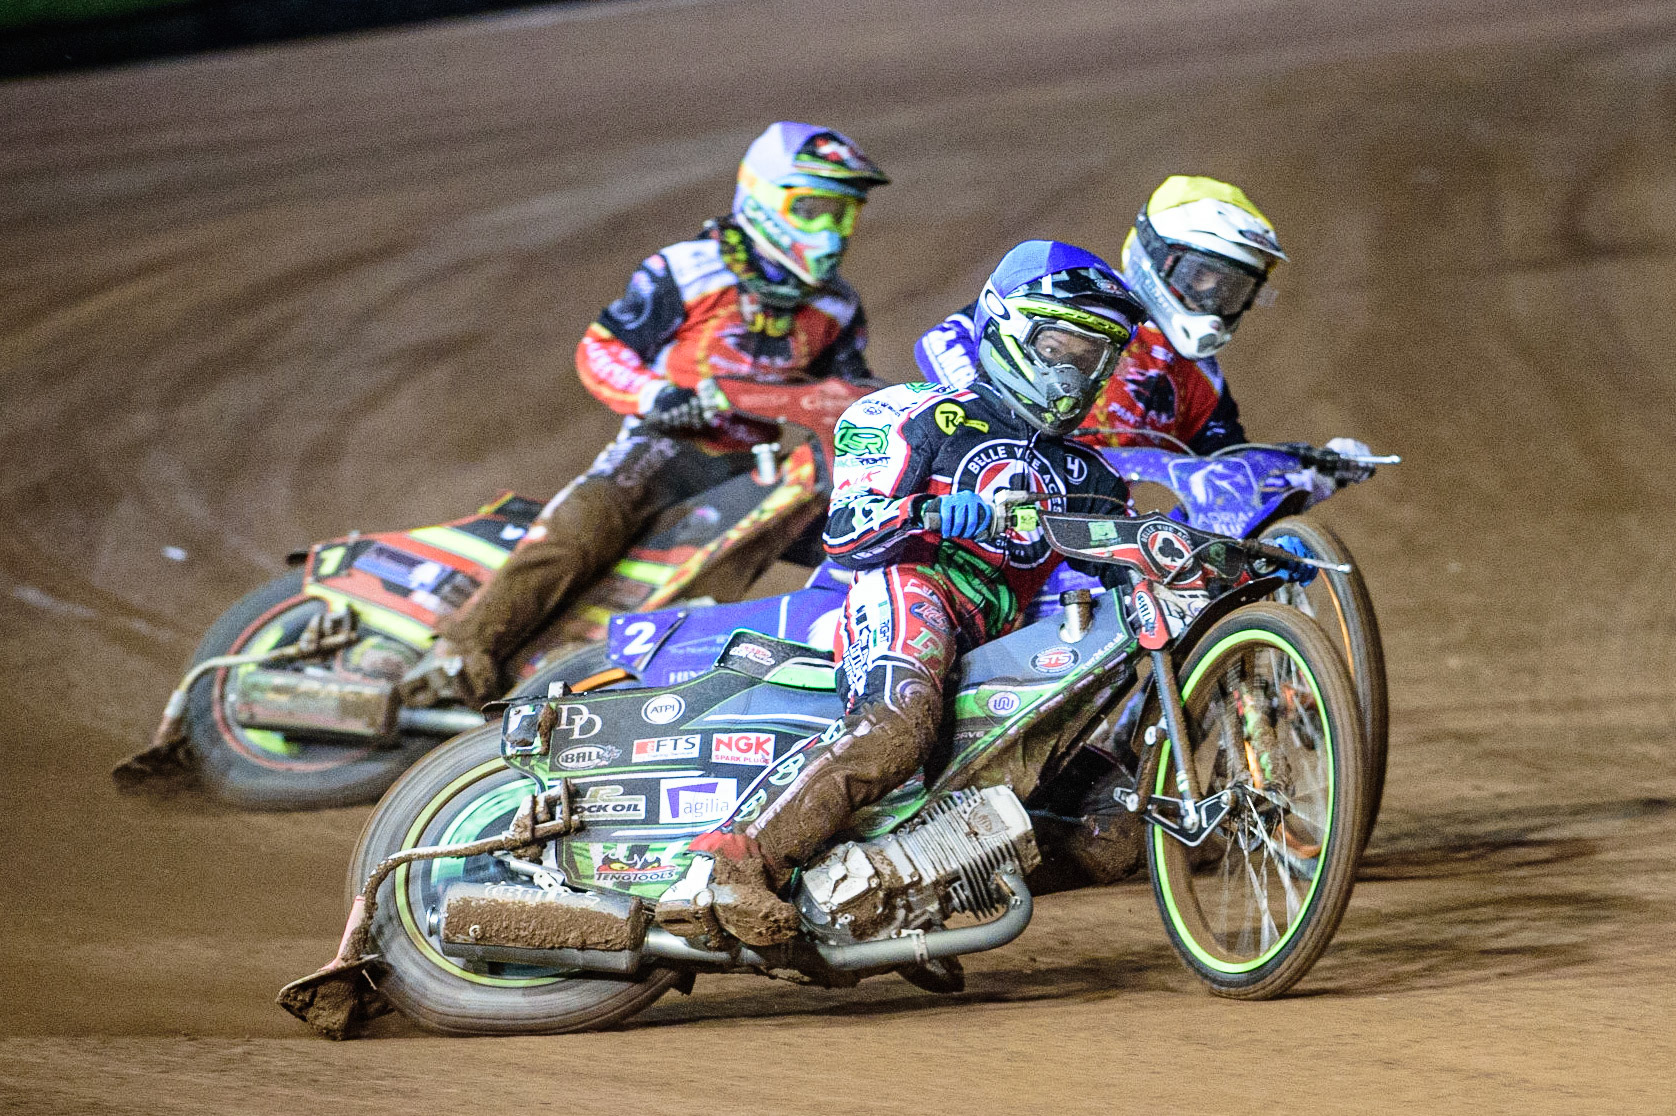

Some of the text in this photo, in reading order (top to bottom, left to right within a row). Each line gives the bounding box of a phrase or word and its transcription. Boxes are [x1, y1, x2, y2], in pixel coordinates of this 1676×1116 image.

[1066, 456, 1080, 479] 4
[967, 446, 1062, 513] BELLE VUE ACES
[319, 546, 346, 576] 1
[623, 621, 656, 656] 2
[1037, 654, 1072, 665] STS
[650, 704, 675, 714] ATPI
[655, 736, 696, 753] FTS
[714, 735, 772, 756] NGK
[714, 754, 771, 765] SPARK PLUGS
[570, 803, 641, 815] OCK OIL
[683, 797, 729, 818] agilia
